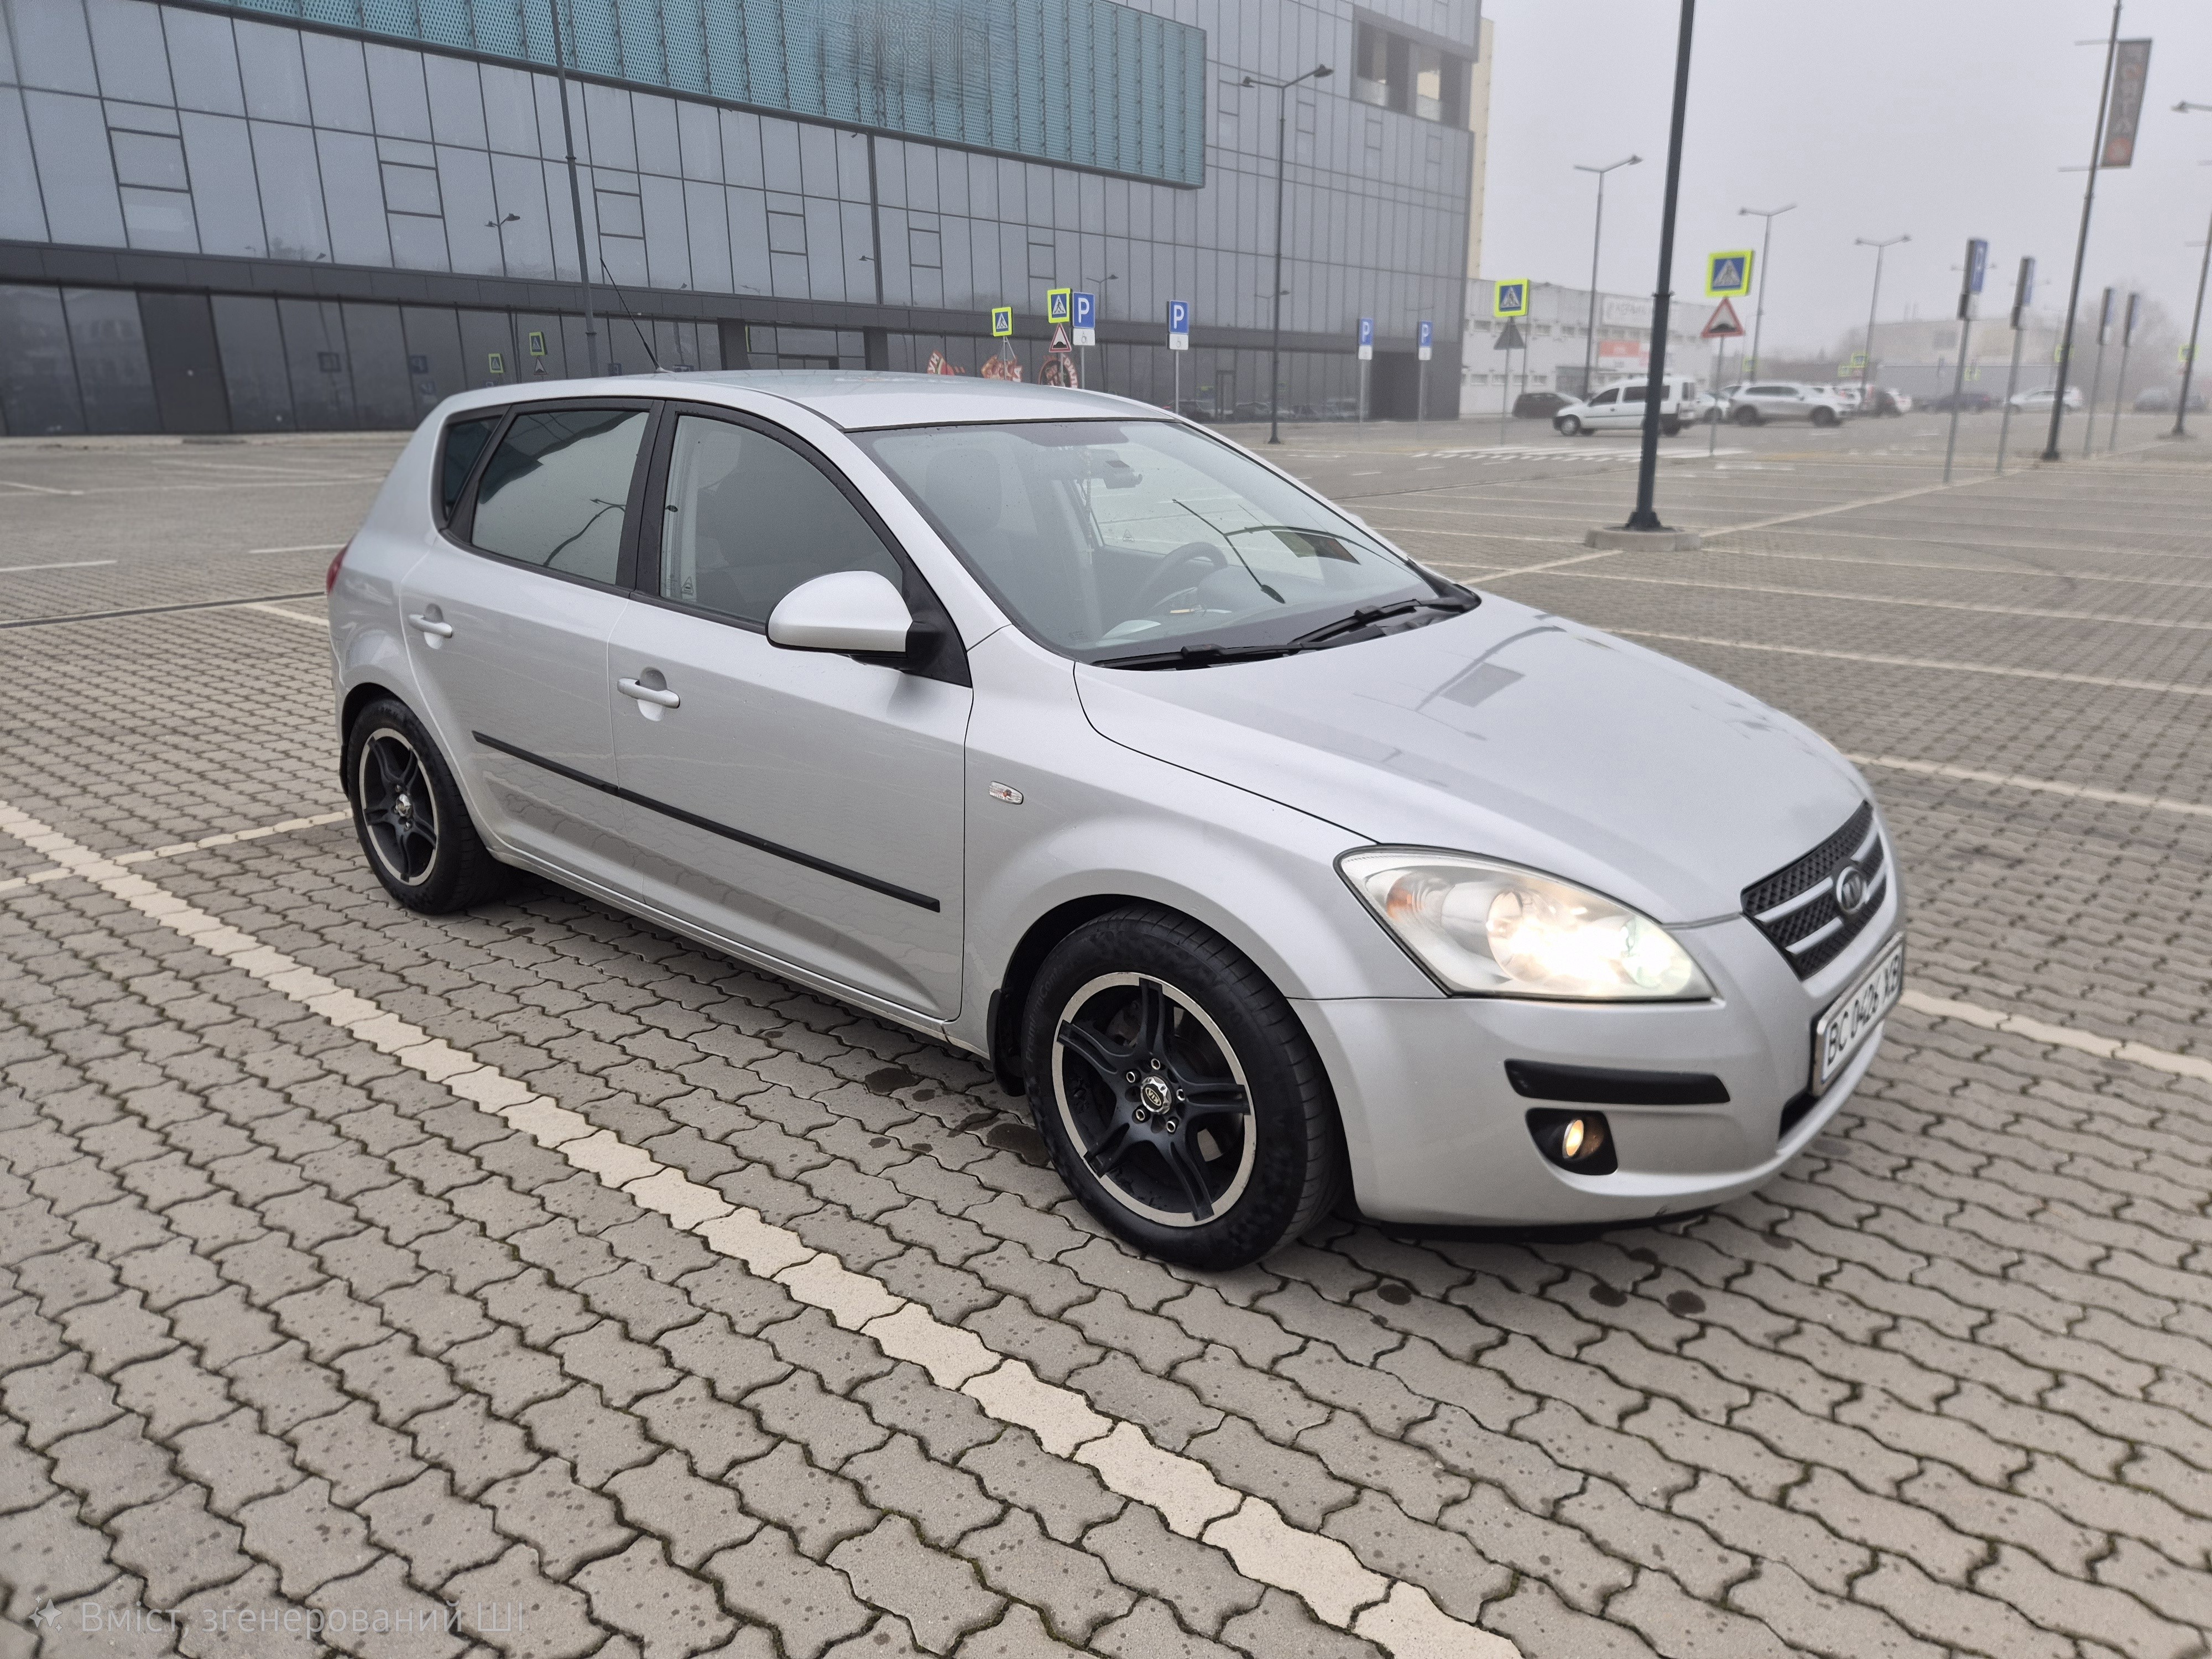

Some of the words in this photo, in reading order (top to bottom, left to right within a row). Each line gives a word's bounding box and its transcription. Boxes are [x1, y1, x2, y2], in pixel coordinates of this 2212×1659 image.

[1078, 298, 1090, 323] P
[1173, 305, 1185, 329] P
[1362, 321, 1370, 342] P
[1421, 324, 1429, 344] P
[1827, 1010, 1849, 1066] BC
[1146, 1088, 1161, 1105] KIA
